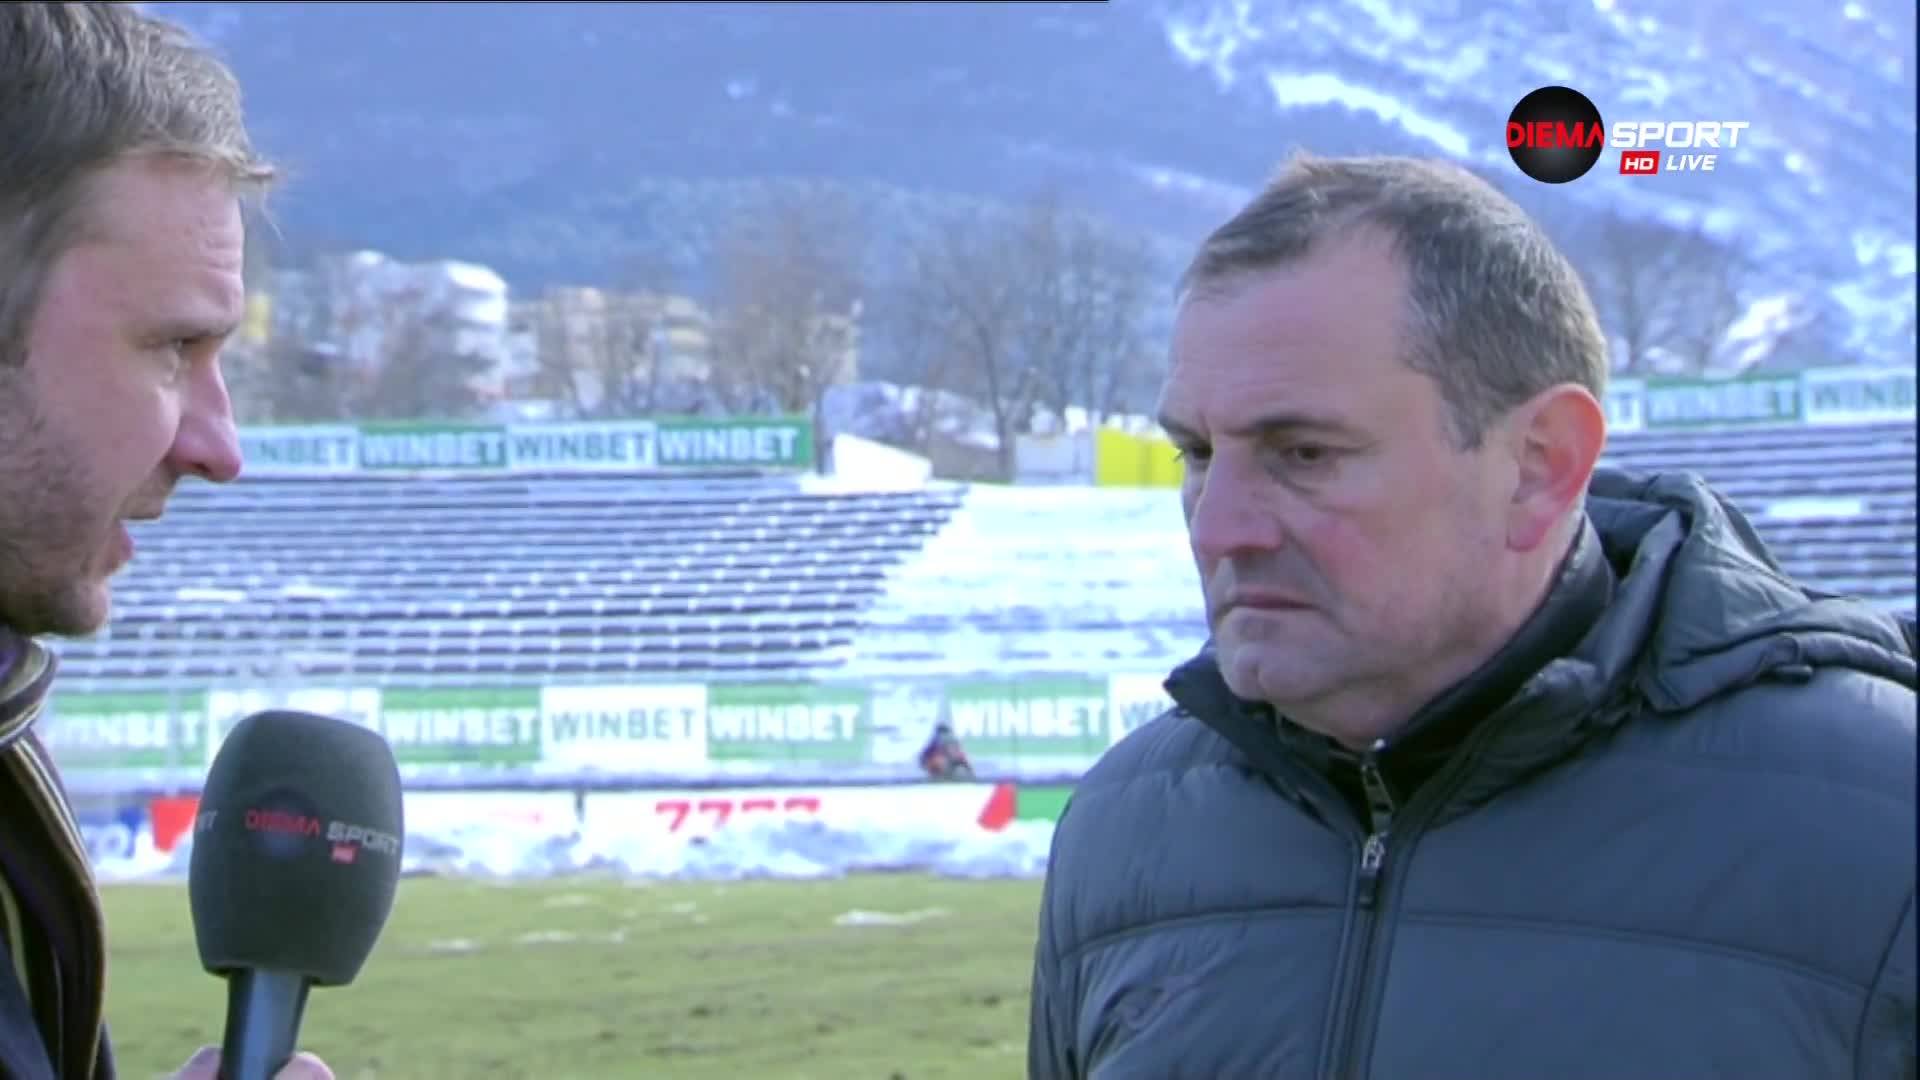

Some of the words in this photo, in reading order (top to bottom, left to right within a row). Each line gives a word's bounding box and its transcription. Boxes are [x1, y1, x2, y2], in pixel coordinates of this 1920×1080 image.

[365, 433, 502, 466] WINBET
[515, 430, 651, 463] WINBET
[658, 427, 798, 461] WINBET
[384, 707, 537, 745] WINBET
[551, 706, 696, 743] WINBET
[709, 702, 860, 743] WINBET
[951, 697, 1104, 737] WINBET
[245, 808, 320, 838] DIEMA
[327, 820, 399, 855] SPORT
